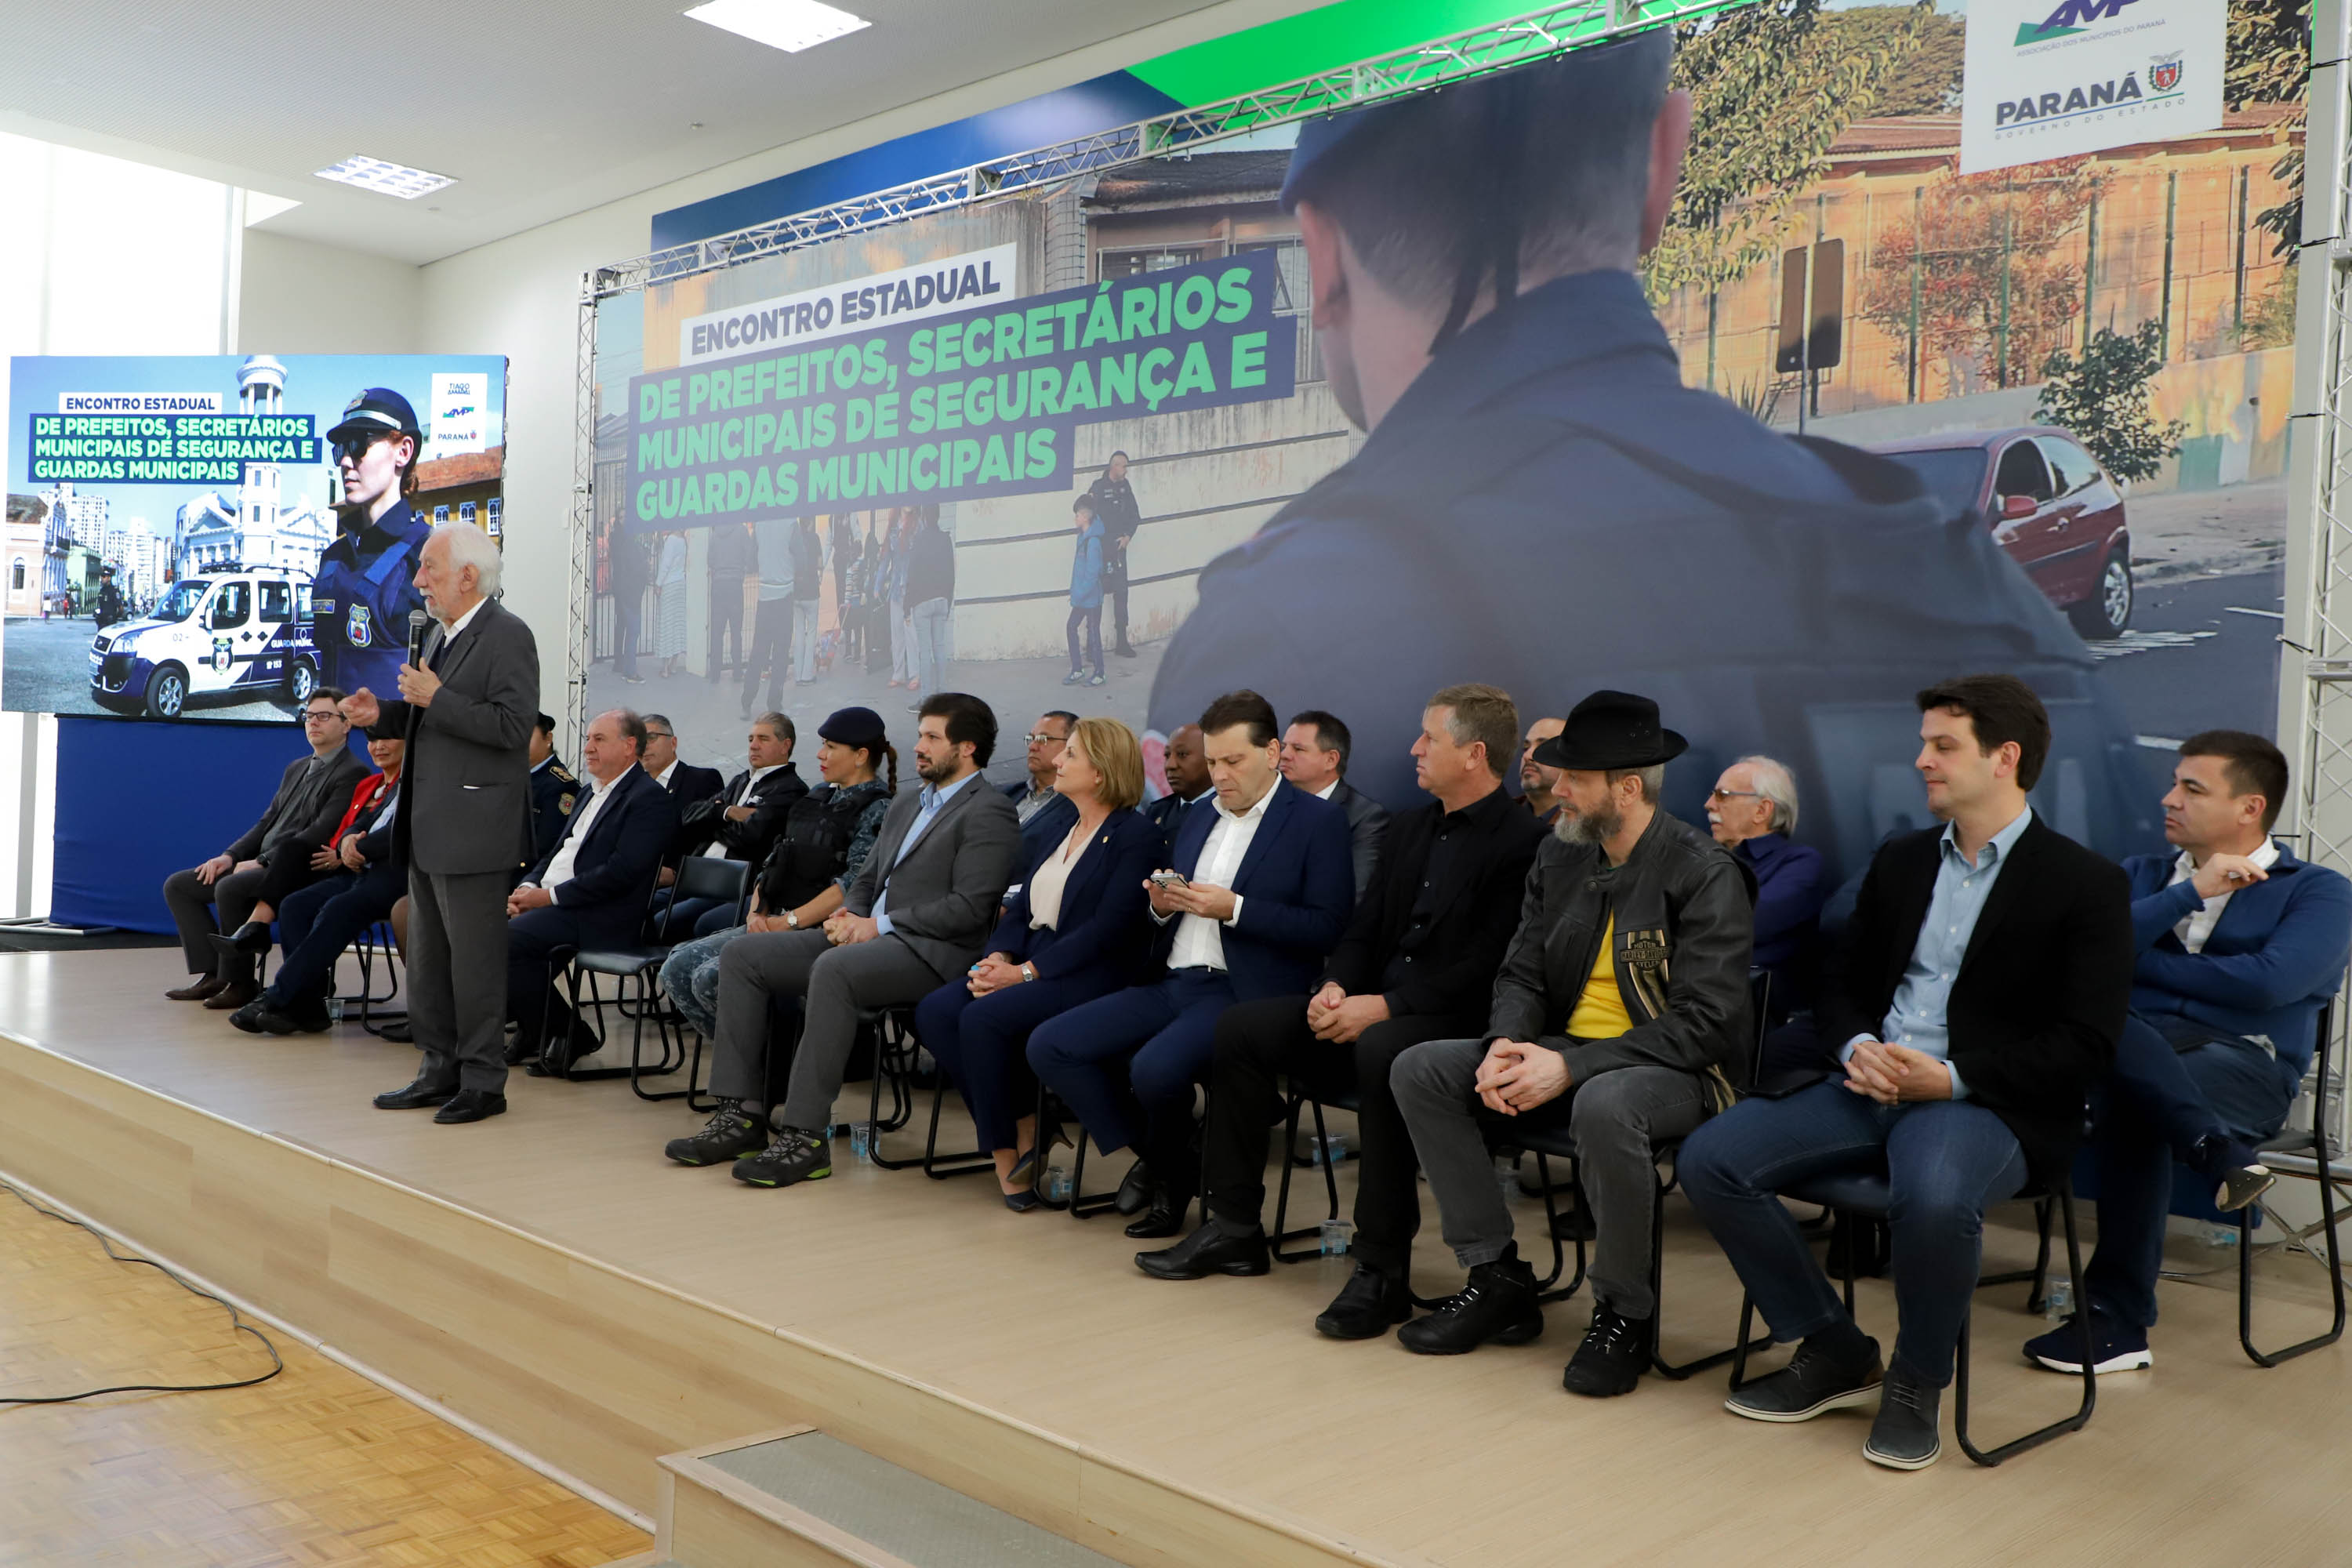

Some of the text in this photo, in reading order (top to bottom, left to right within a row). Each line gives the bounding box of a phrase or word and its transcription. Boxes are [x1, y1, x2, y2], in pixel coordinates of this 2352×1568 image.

[2016, 18, 2166, 57] ASSOCIAÇÃO DOS MUNICÍPIOS DO PARANÁ
[1996, 71, 2143, 125] PARANÁ
[1995, 98, 2186, 140] GOVERNO DO ESTADO
[691, 260, 1001, 355] ENCONTRO ESTADUAL
[639, 267, 1254, 423] DE PREFEITOS, SECRETÁRIOS
[67, 397, 215, 410] ENCONTRO ESTADUAL
[638, 331, 1269, 474] MUNICIPAIS DE SEGURANÇA E
[35, 415, 309, 439] DE PREFEITOS, SECRETÁRIOS
[34, 460, 239, 480] GUARDAS MUNICIPAIS
[35, 439, 314, 462] MUNICIPAIS DE SEGURANÇA E
[636, 427, 1057, 521] GUARDAS MUNICIPAIS
[270, 639, 294, 648] GUARDA
